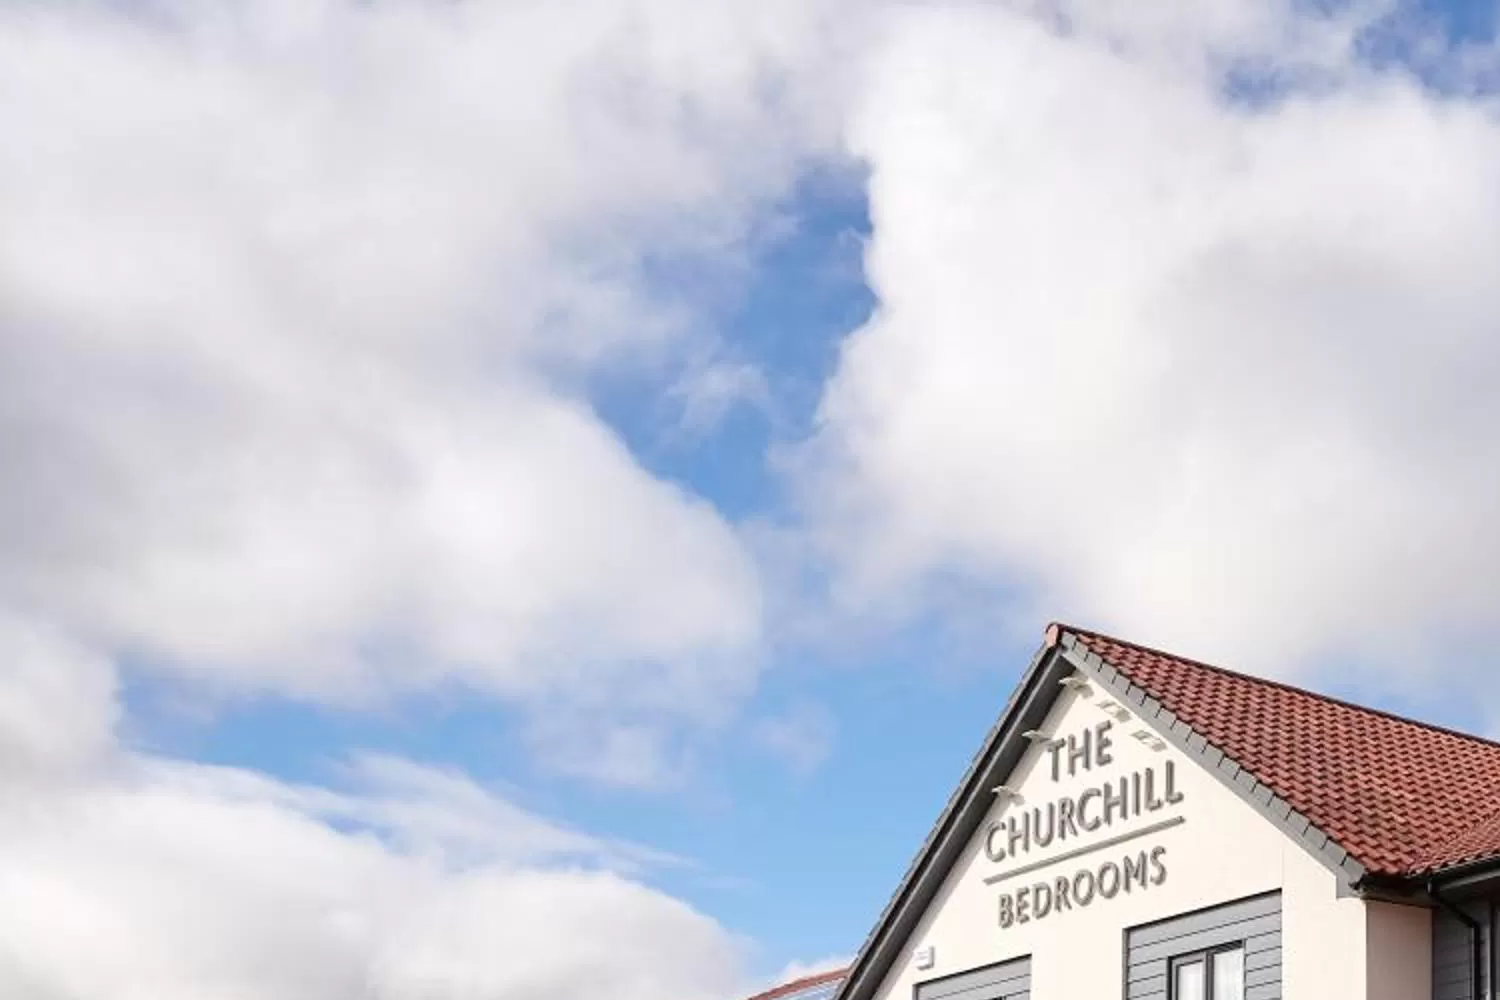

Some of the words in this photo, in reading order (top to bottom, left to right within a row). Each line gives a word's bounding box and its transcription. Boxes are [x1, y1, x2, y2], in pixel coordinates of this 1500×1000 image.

[1047, 720, 1113, 782] THE
[984, 760, 1185, 862] CHURCHILL
[998, 846, 1167, 929] BEDROOMS
